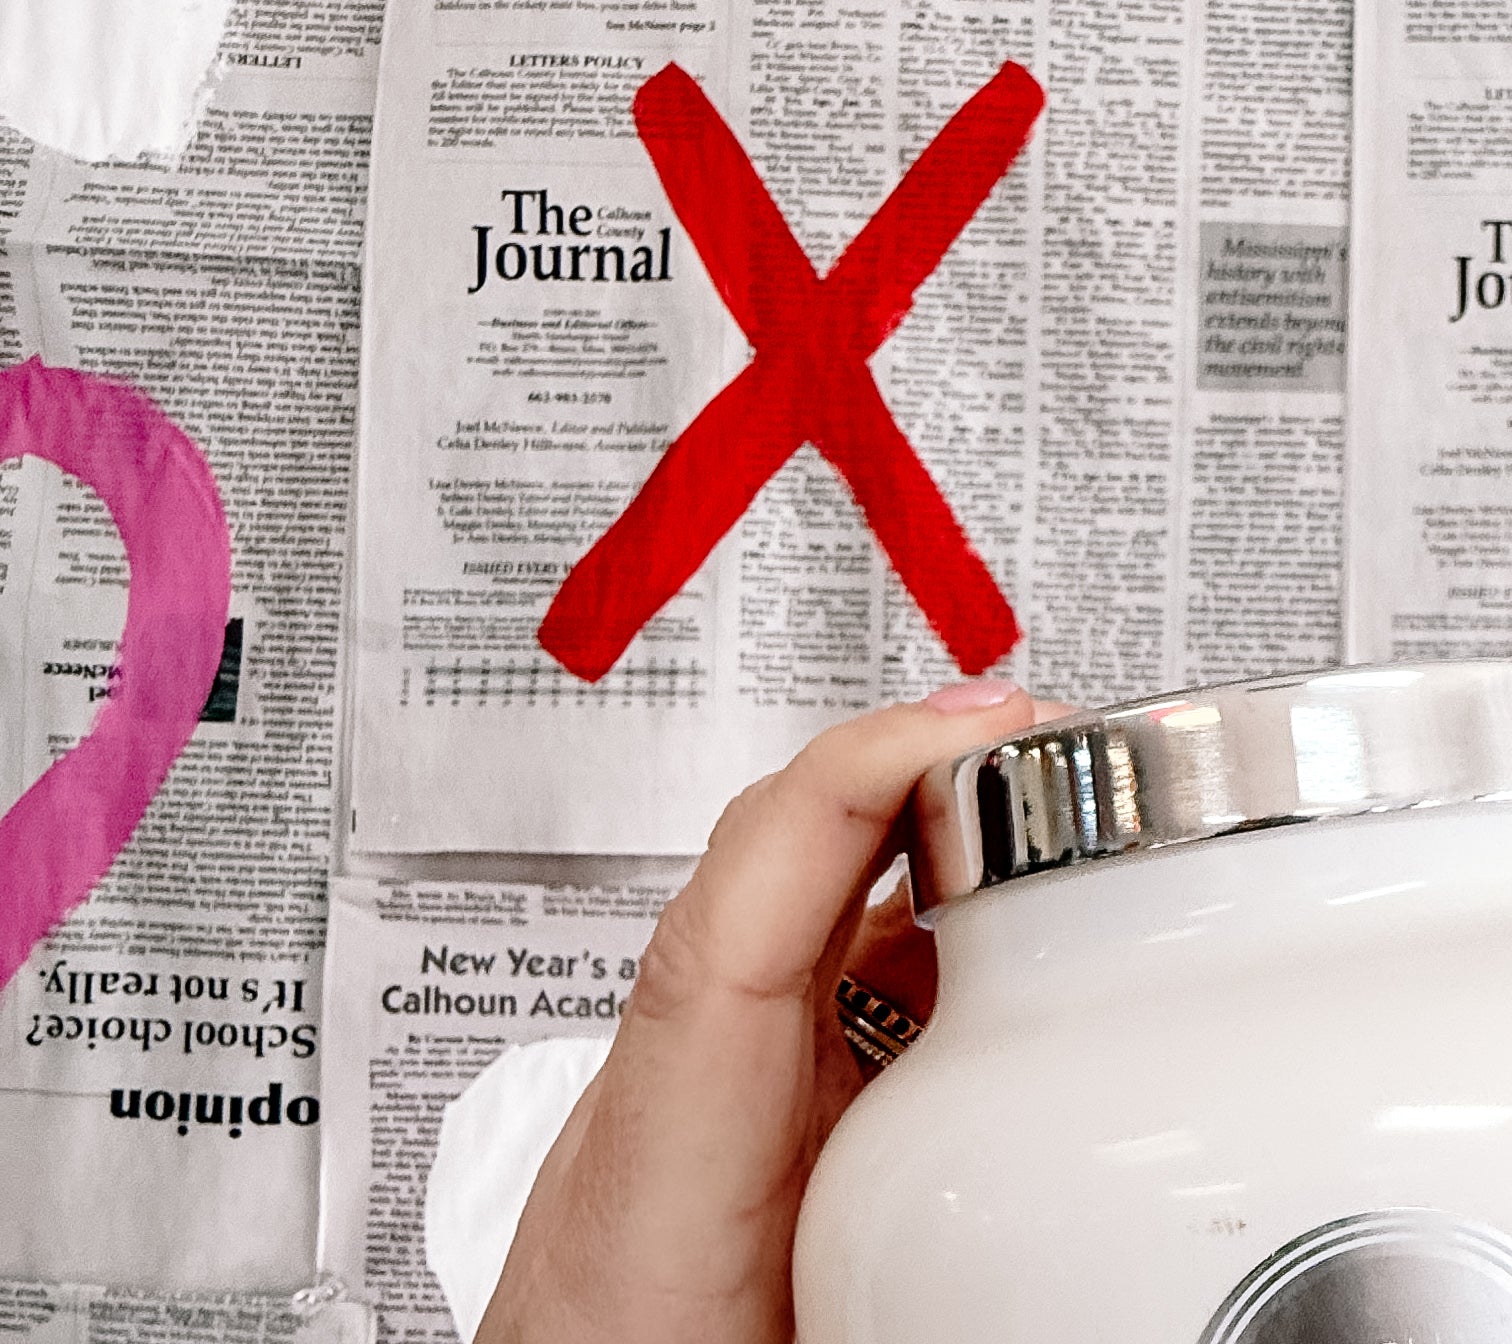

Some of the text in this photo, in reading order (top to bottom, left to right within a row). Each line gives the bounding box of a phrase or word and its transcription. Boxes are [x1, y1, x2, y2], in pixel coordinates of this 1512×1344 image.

[501, 189, 593, 237] The
[467, 224, 674, 295] Journal
[540, 61, 1045, 681] X
[39, 959, 308, 1014] It's not really.
[421, 944, 608, 981] New Year's
[382, 985, 518, 1017] Calhoun
[25, 1013, 318, 1060] School choice?
[110, 1083, 321, 1140] opinion
